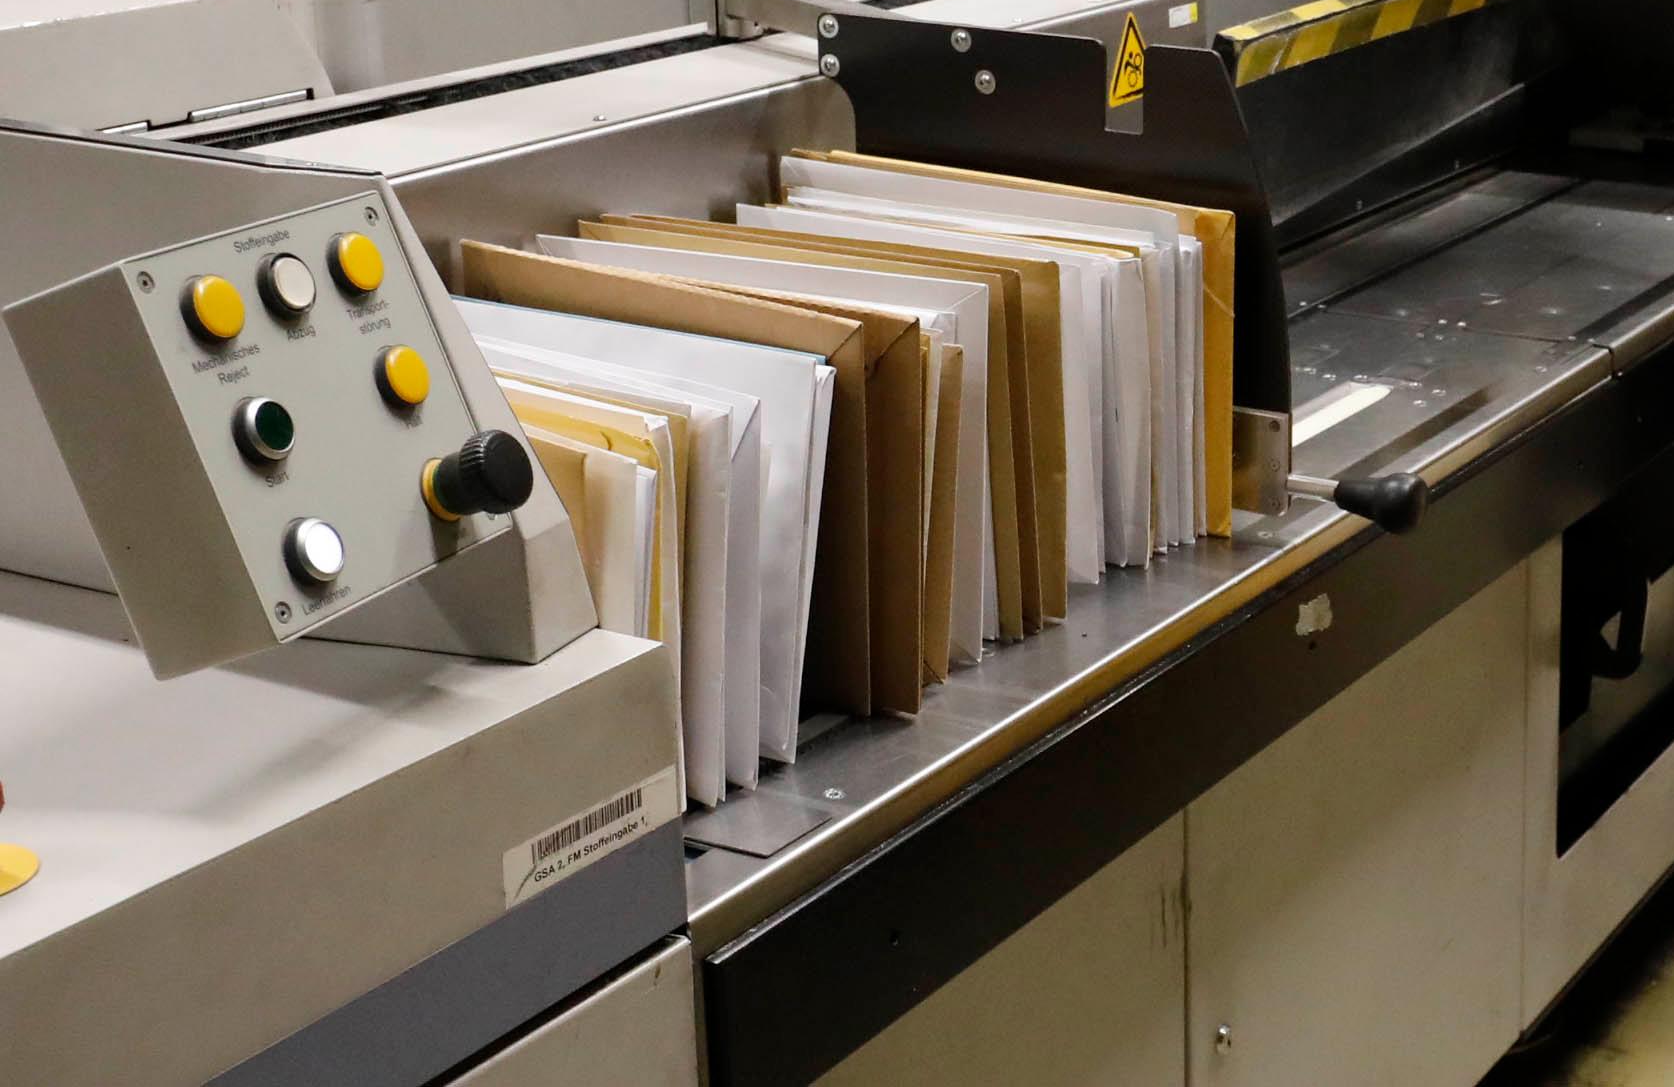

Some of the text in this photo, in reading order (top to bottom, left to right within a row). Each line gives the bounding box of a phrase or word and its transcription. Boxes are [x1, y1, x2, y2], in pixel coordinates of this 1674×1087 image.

[233, 229, 291, 253] Stoffeingabe
[286, 325, 317, 342] Abzug
[192, 342, 261, 374] Mechanisches
[216, 365, 250, 385] Reject
[264, 470, 290, 488] Start
[534, 864, 556, 882] GSA
[567, 851, 582, 865] FM
[583, 821, 639, 856] Stoffeingabe
